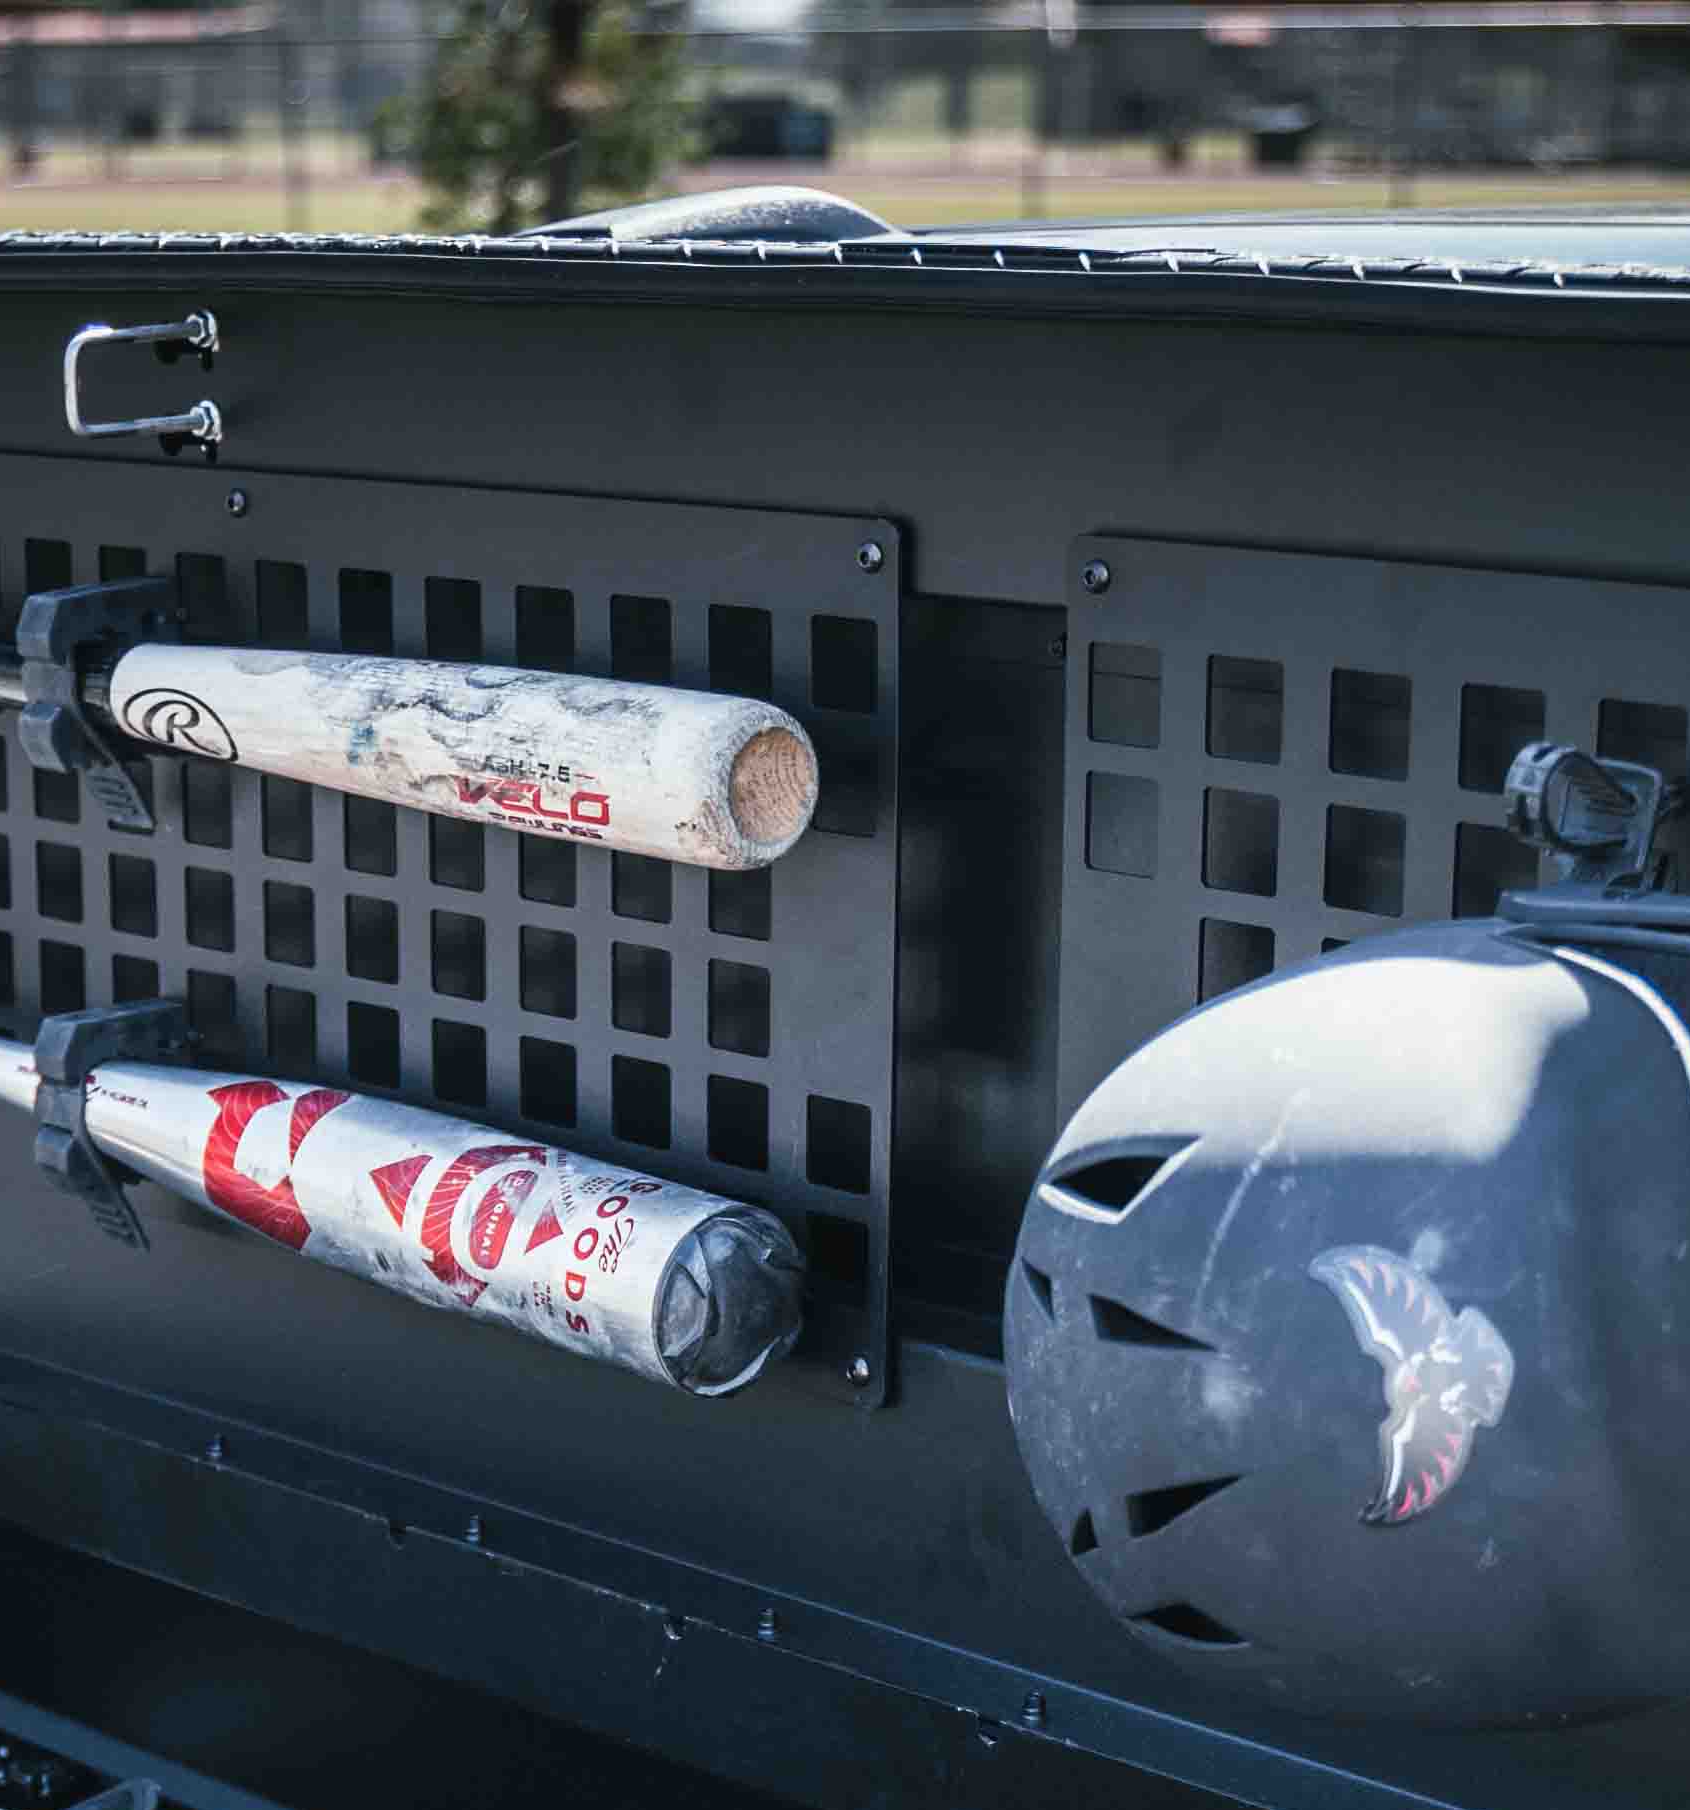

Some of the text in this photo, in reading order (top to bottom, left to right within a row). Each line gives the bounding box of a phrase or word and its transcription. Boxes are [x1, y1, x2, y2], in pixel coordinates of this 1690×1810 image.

[137, 696, 225, 756] R
[452, 774, 611, 827] VELO
[564, 1181, 663, 1334] GOODS
[598, 1216, 634, 1274] The
